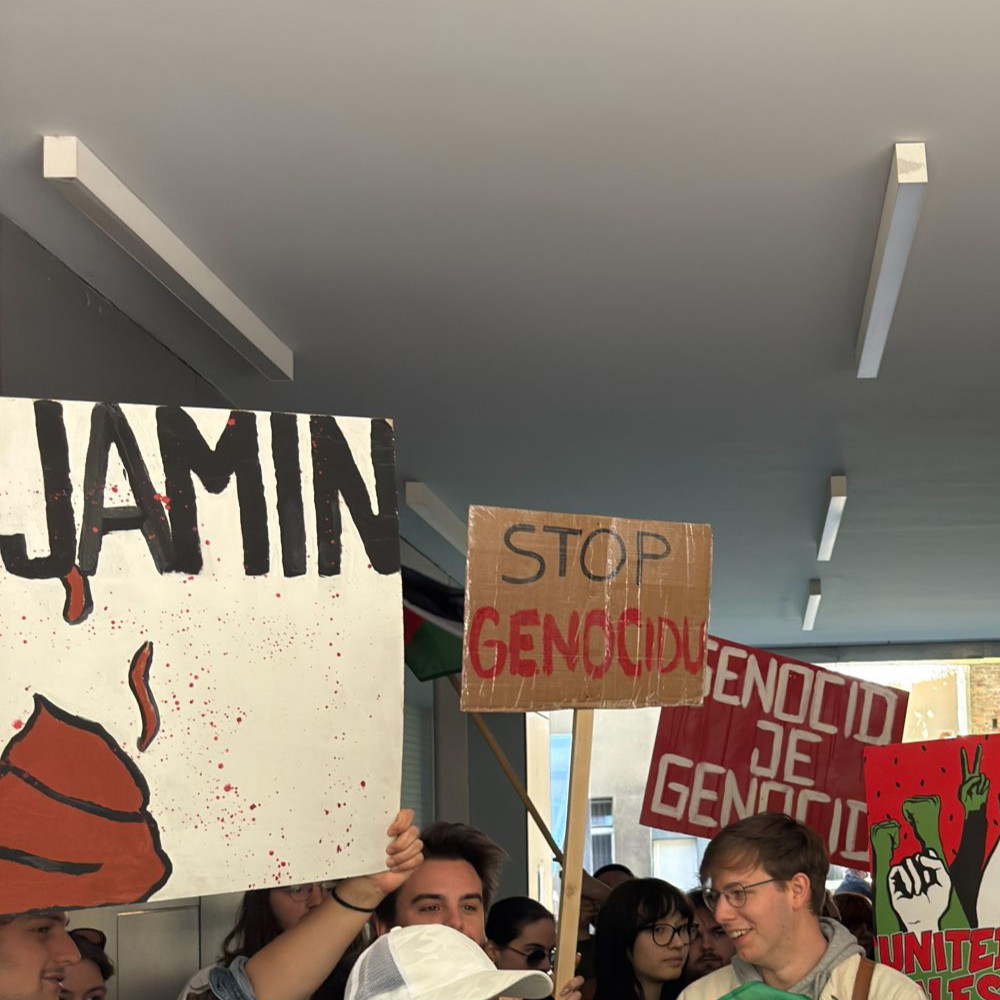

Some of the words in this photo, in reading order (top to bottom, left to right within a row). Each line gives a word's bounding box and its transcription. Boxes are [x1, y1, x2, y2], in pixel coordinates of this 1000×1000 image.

[0, 399, 401, 579] JAMIN
[502, 523, 671, 585] STOP
[469, 605, 706, 679] GENOCIDU
[750, 720, 822, 787] JE
